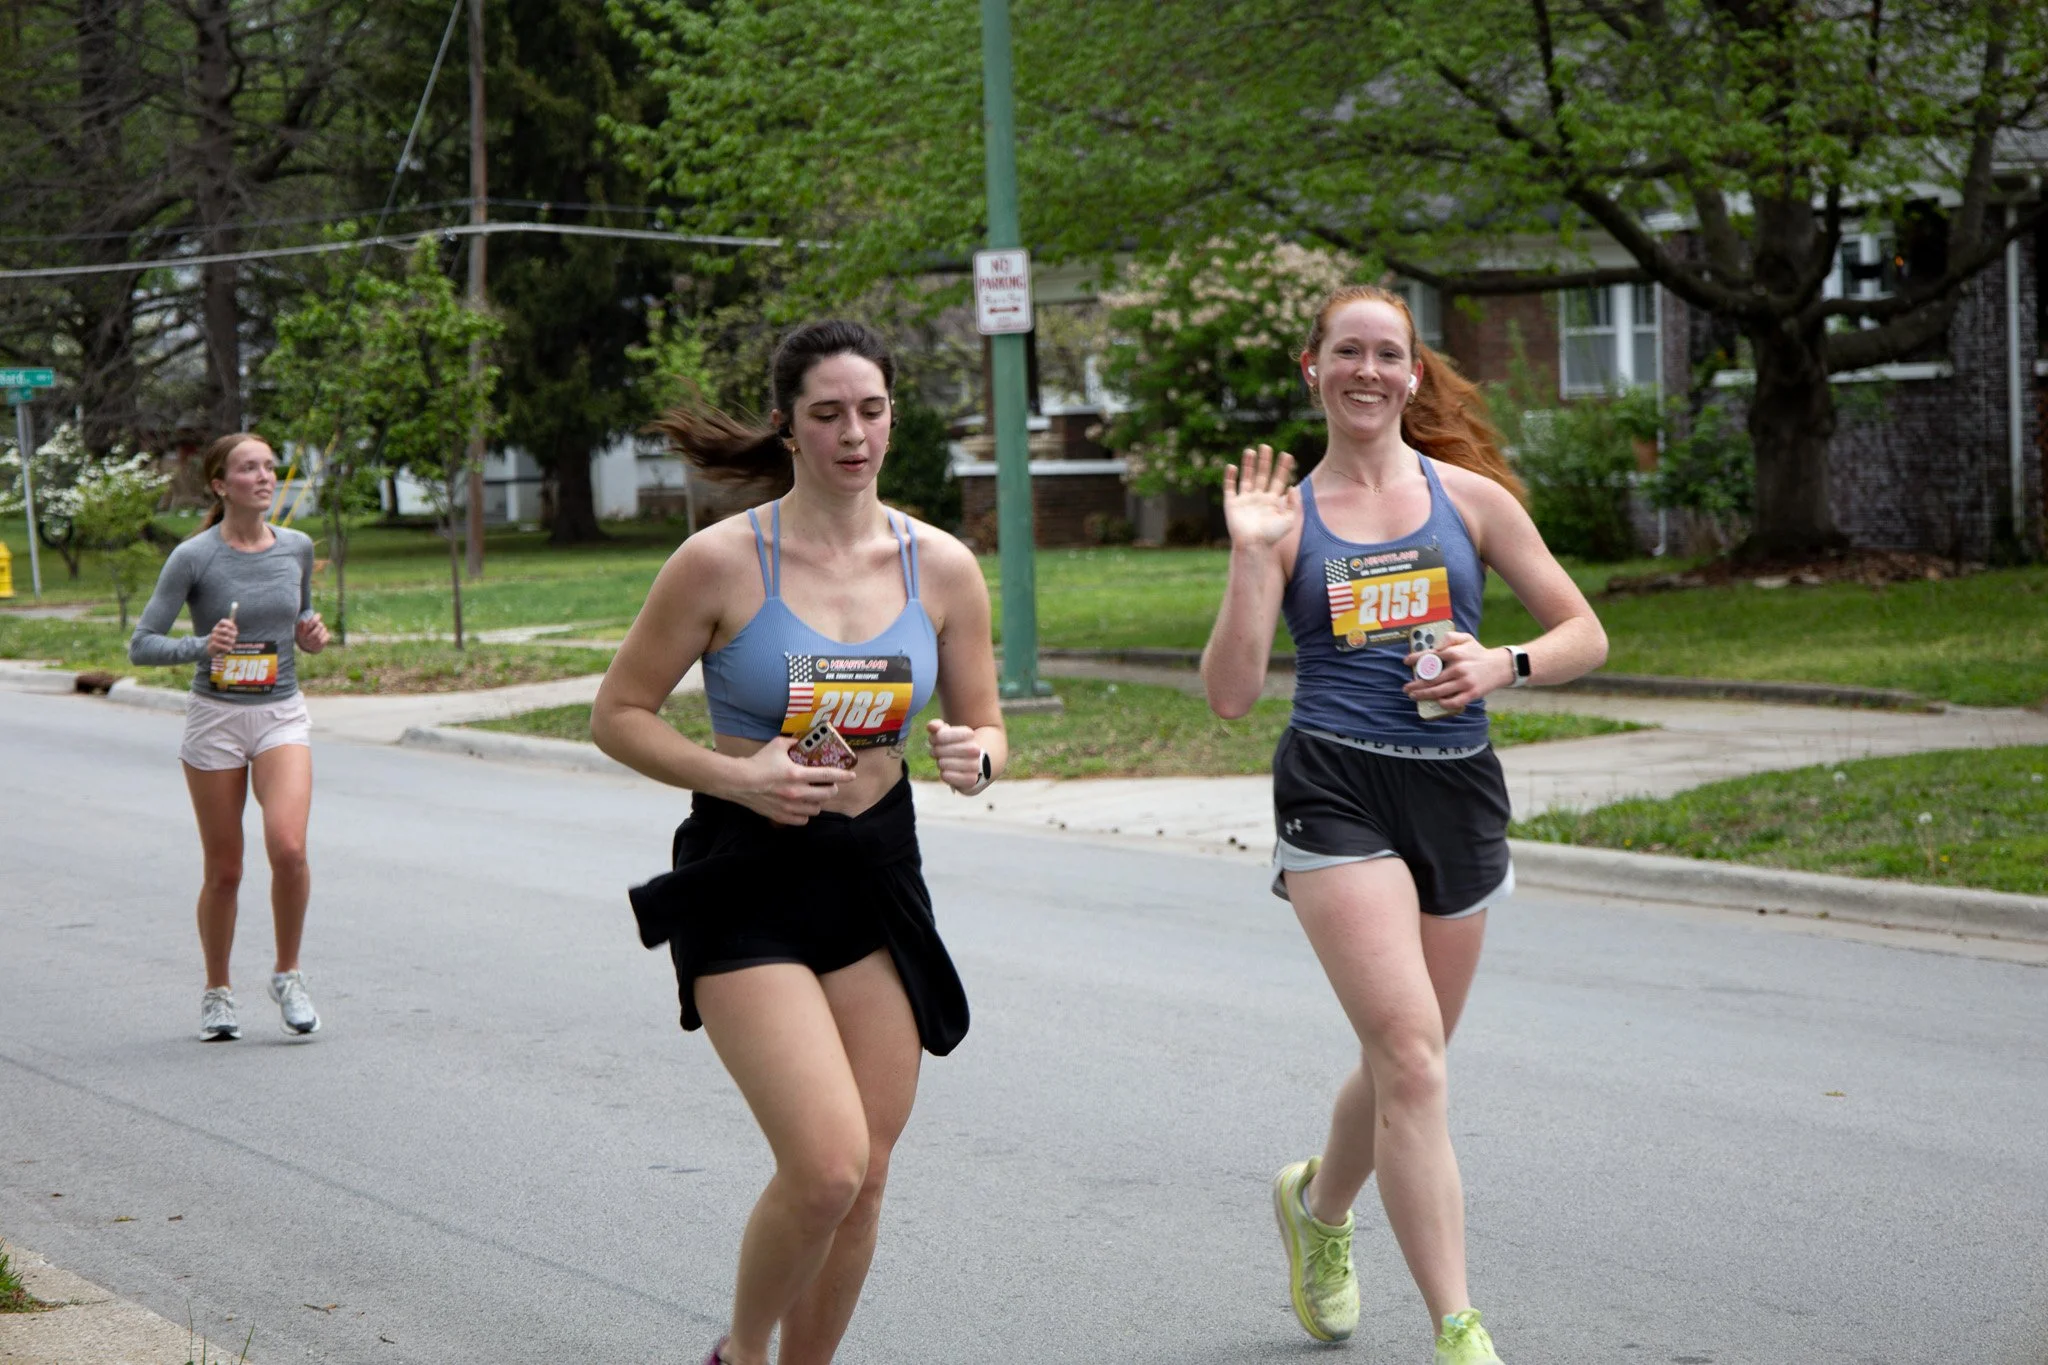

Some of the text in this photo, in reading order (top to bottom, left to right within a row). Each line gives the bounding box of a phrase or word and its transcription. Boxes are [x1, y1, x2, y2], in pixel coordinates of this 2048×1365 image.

[991, 258, 1010, 273] NO
[979, 275, 1025, 290] PARKING
[1358, 577, 1431, 625] 2153
[222, 658, 270, 682] 2306
[809, 690, 895, 729] 2182
